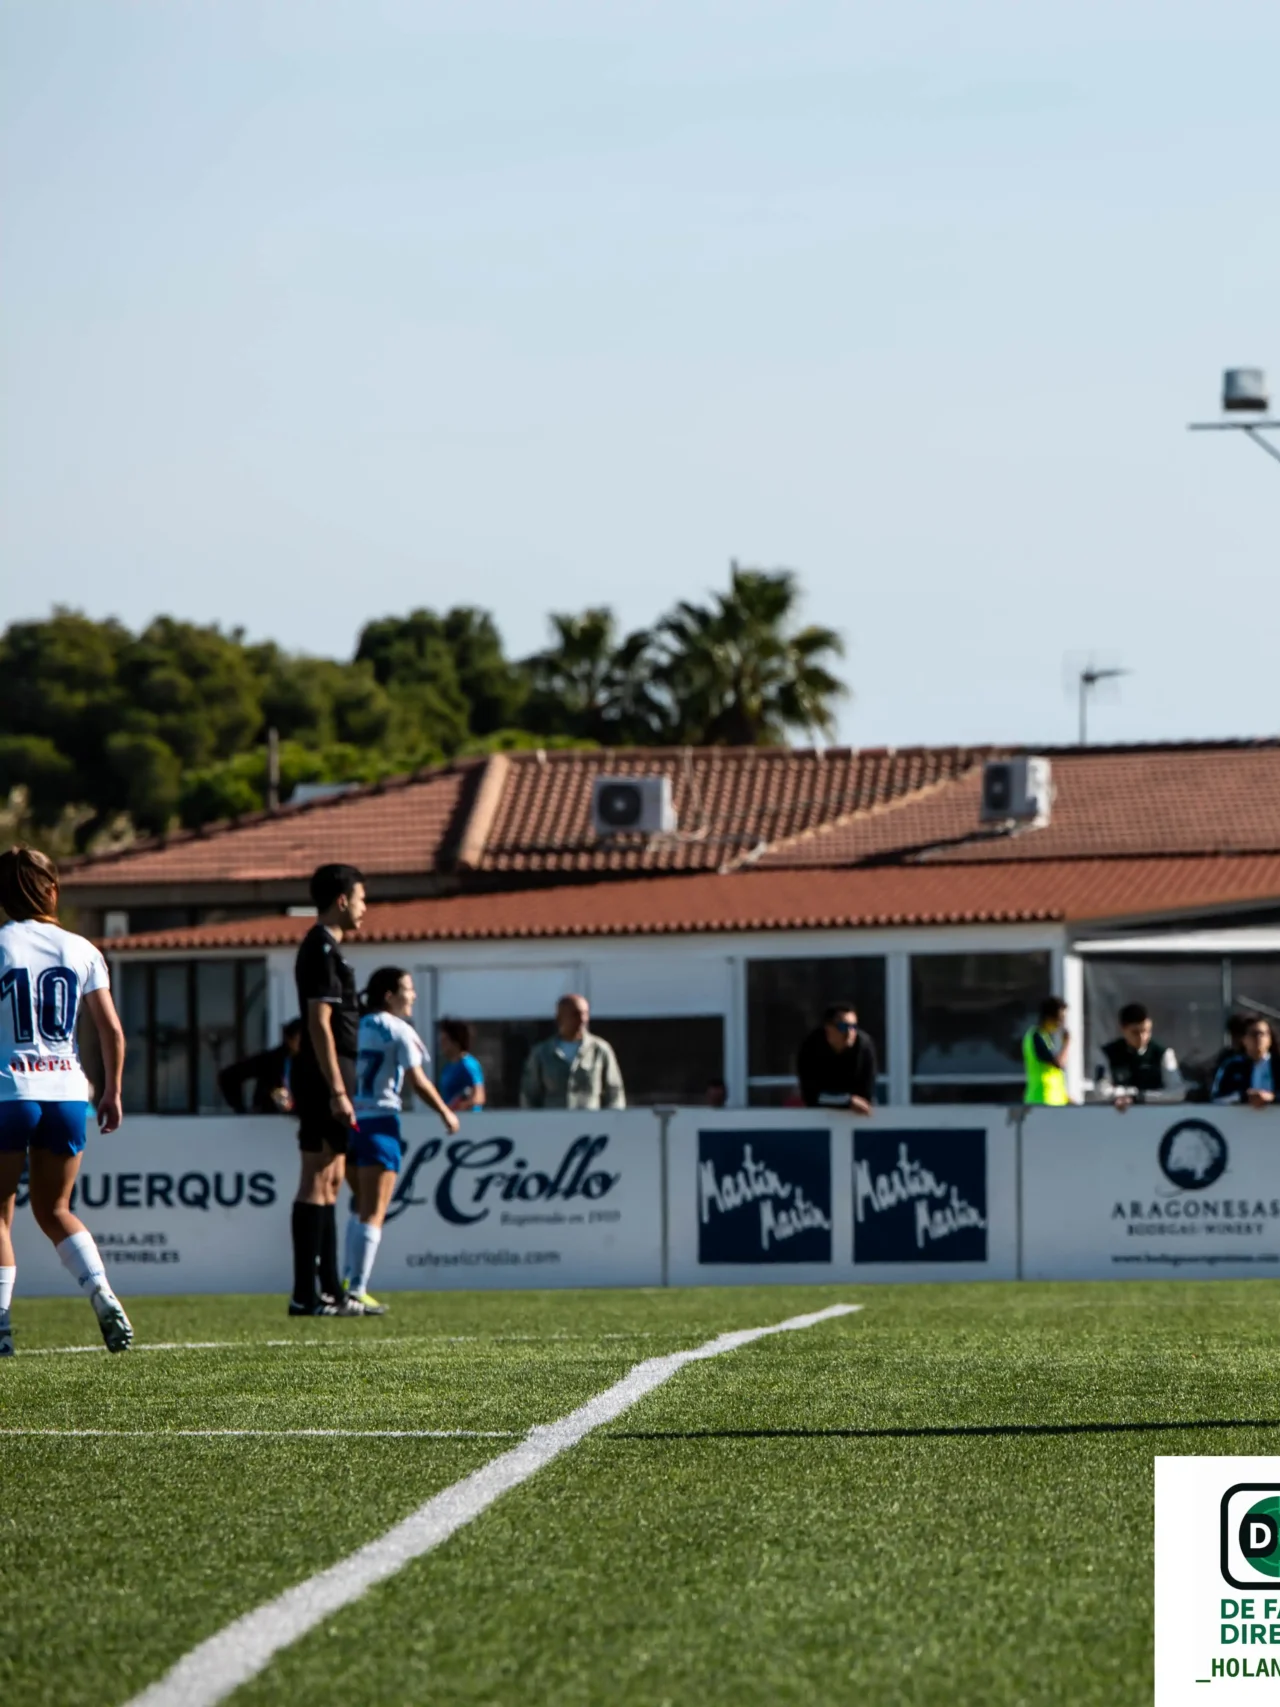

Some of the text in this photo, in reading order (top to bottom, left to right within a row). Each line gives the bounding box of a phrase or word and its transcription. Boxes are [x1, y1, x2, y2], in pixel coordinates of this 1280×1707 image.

[0, 966, 80, 1044] 10
[69, 1170, 278, 1212] UERQUS
[434, 1134, 622, 1227] Criollo
